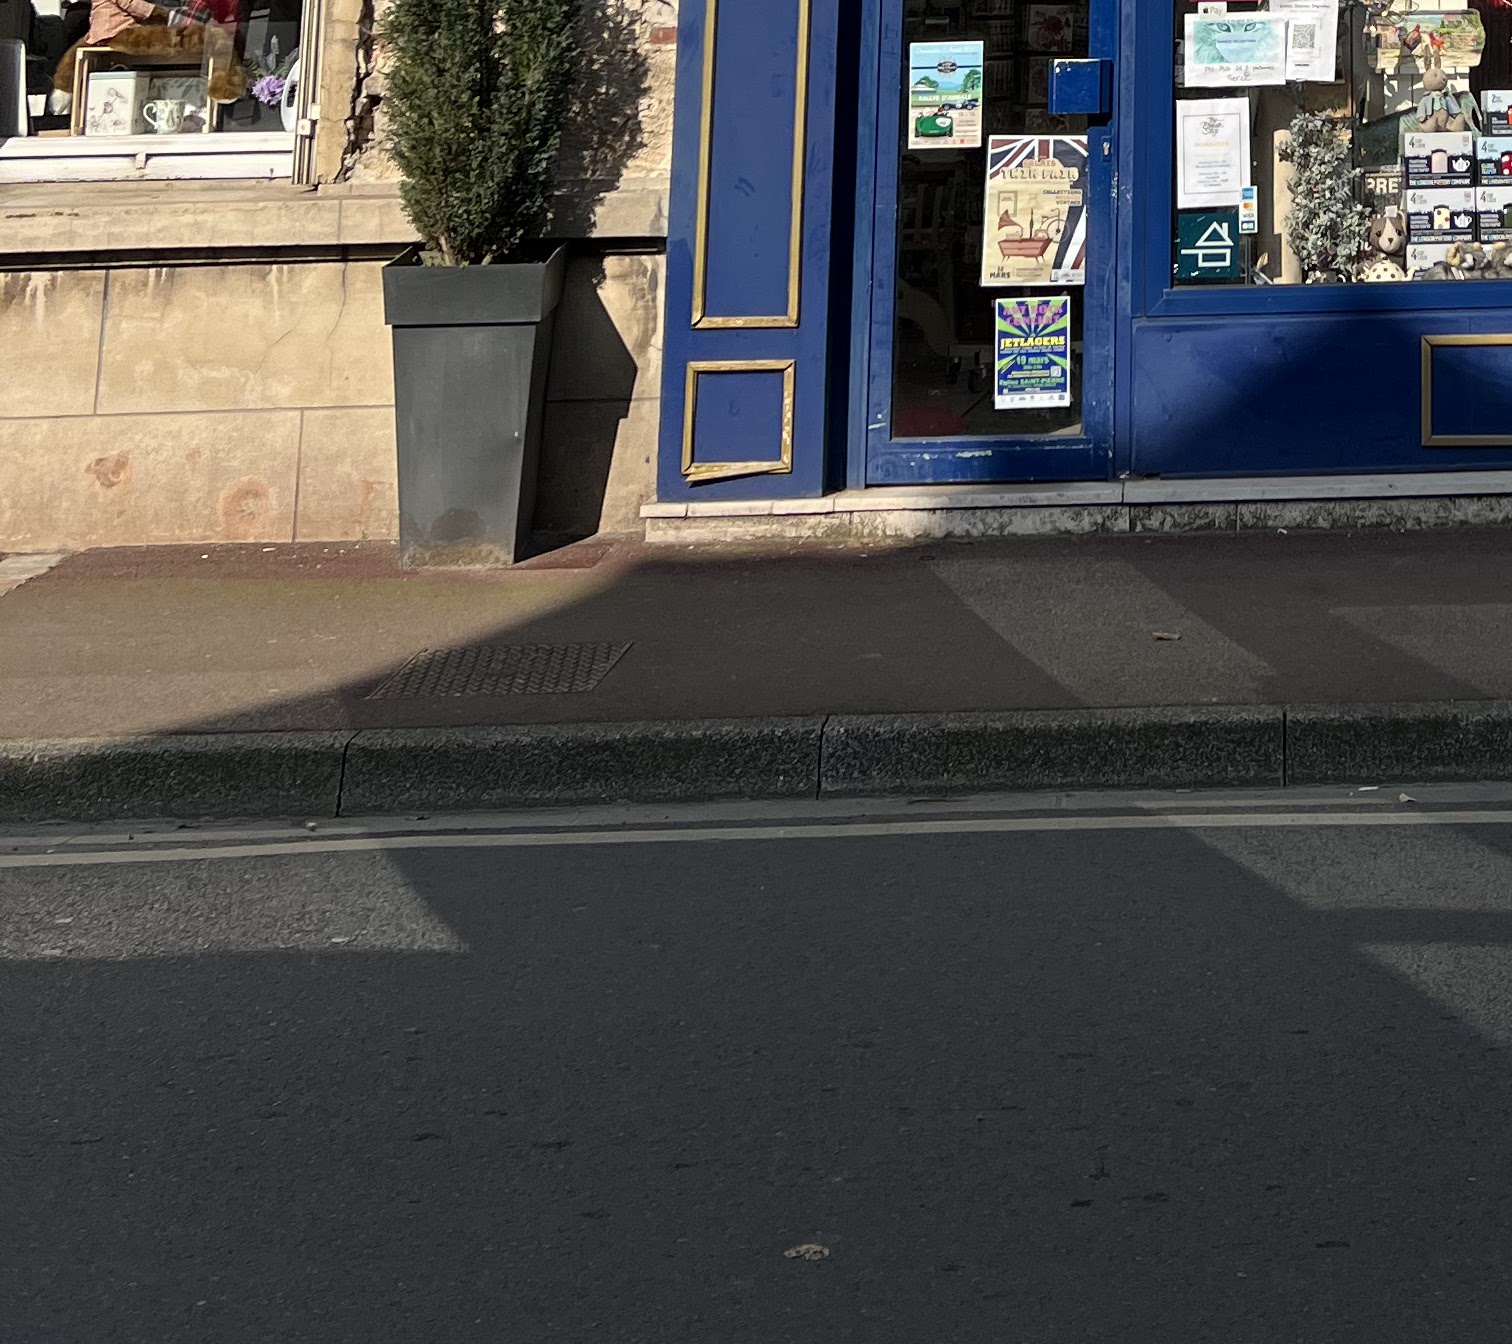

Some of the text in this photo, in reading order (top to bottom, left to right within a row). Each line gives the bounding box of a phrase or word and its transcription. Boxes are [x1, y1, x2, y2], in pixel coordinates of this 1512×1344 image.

[1210, 6, 1224, 16] Pay
[1408, 136, 1415, 149] 4
[1481, 141, 1487, 153] 4
[1365, 177, 1402, 194] PRE
[1410, 192, 1416, 204] 4
[1411, 248, 1417, 260] 4
